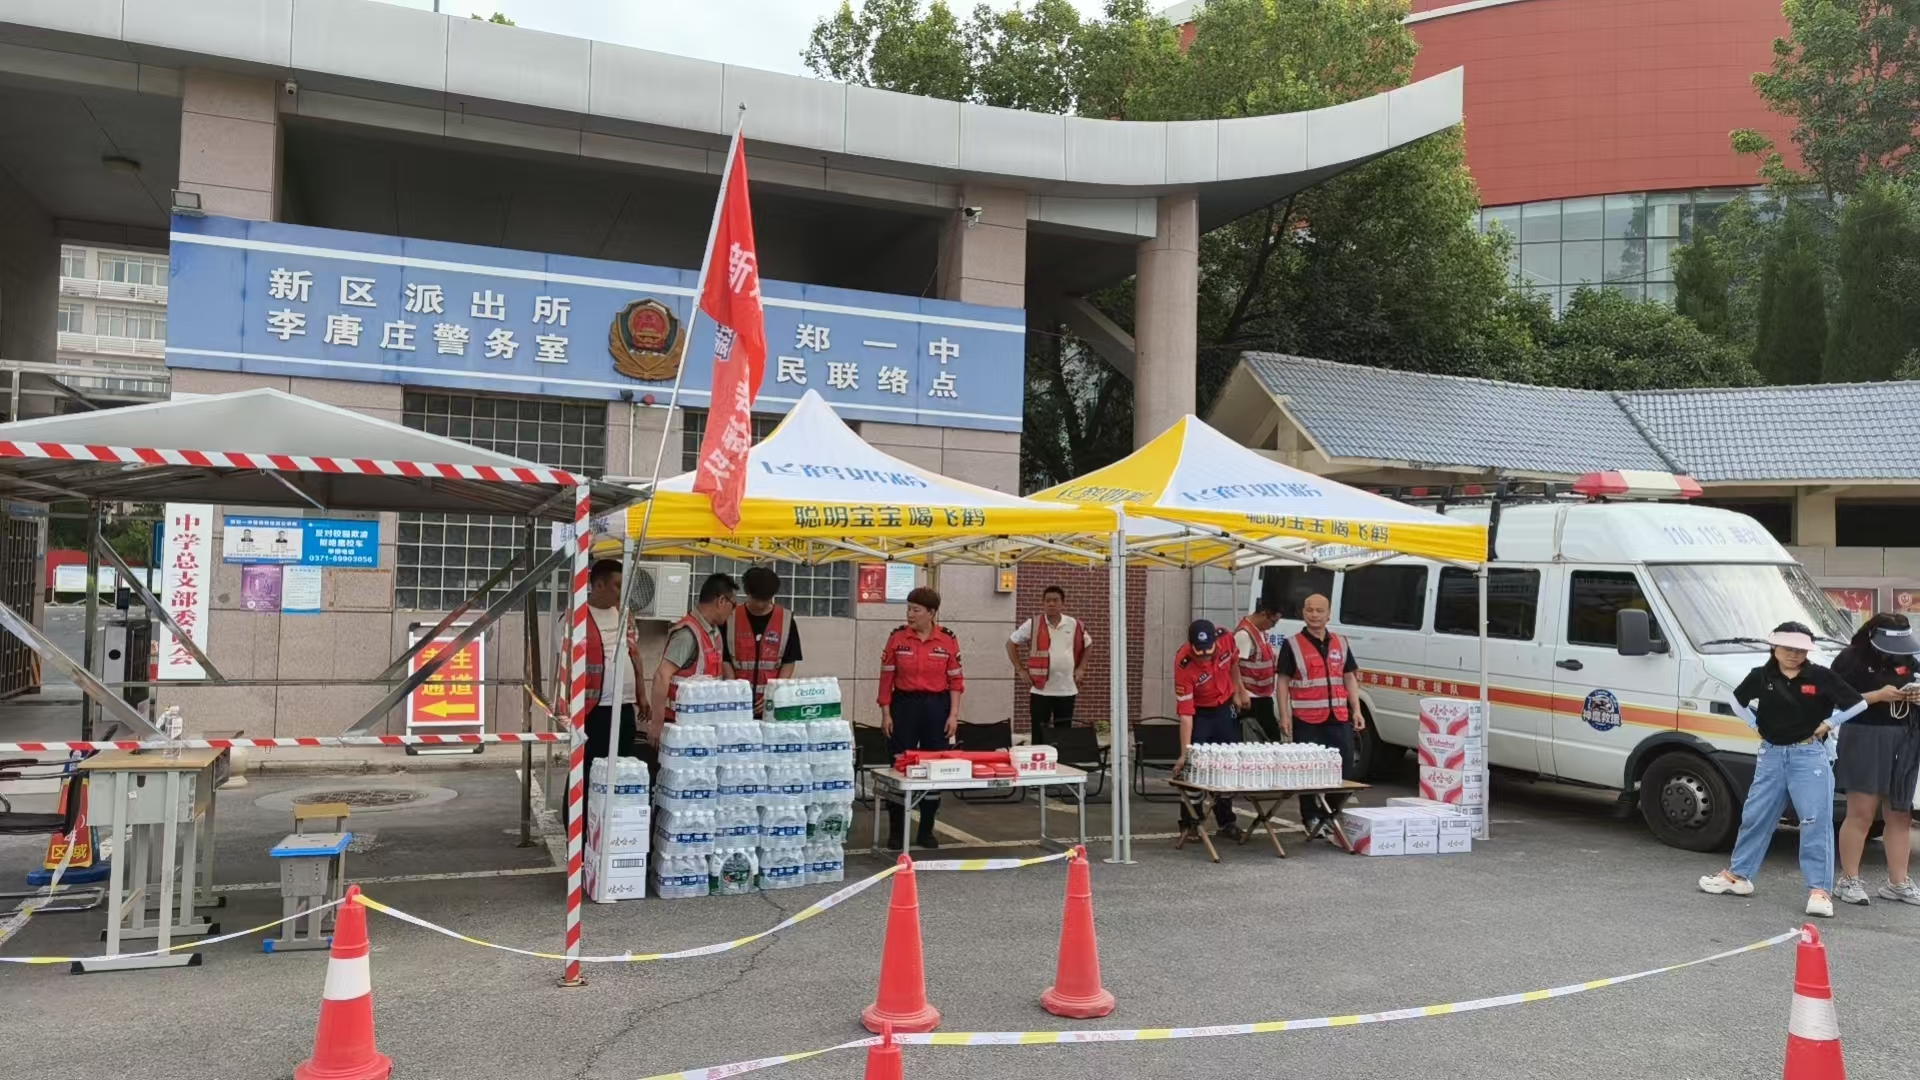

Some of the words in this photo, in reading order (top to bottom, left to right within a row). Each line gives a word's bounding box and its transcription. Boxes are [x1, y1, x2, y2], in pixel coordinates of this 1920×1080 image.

[269, 266, 571, 326] 新区派出所
[266, 308, 569, 365] 李唐庄警务室
[795, 324, 959, 365] 郑一中
[776, 355, 959, 399] 民联络点
[793, 505, 985, 529] 聪明宝宝喝飞鹤
[610, 836, 639, 847] 娃哈哈
[607, 884, 637, 895] 娃哈哈
